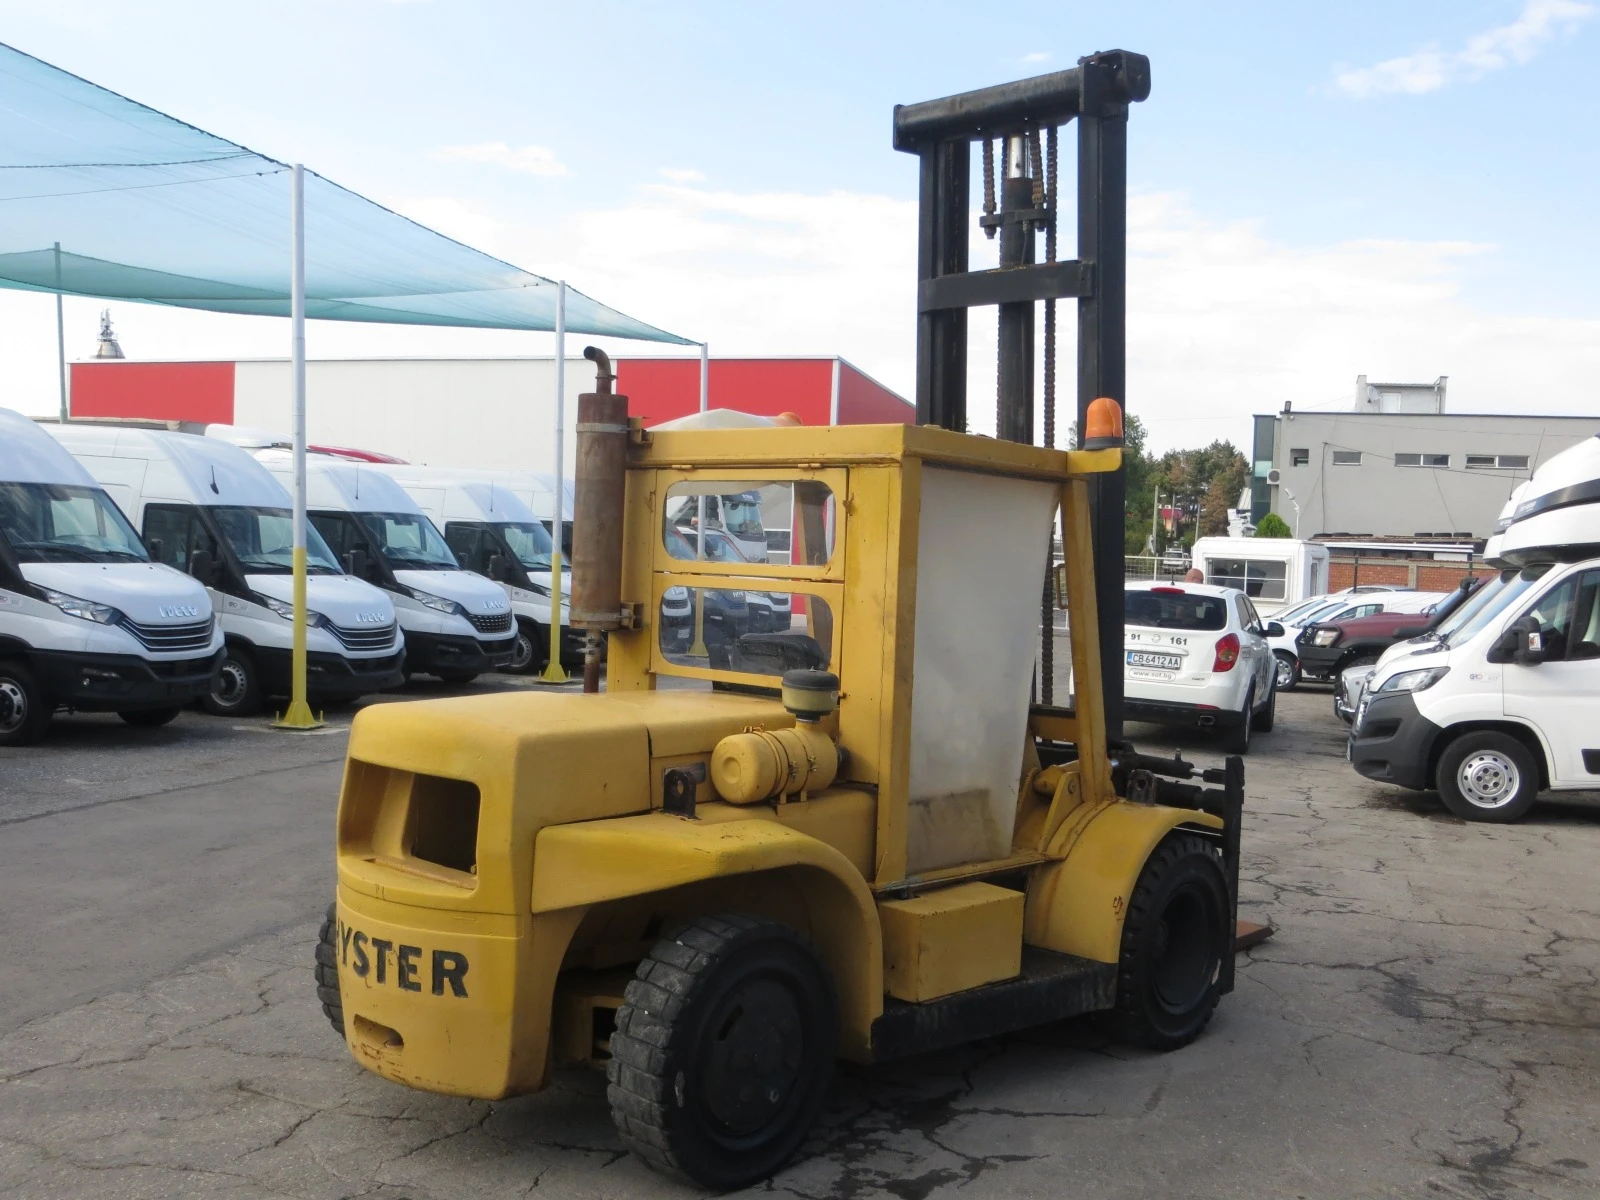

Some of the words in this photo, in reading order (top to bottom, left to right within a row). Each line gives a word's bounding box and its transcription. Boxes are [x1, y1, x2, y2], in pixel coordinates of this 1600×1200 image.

[1130, 633, 1141, 641] 91
[1170, 636, 1188, 646] 161
[1132, 653, 1144, 663] CB
[1145, 655, 1167, 666] 6412
[1167, 657, 1179, 667] AA
